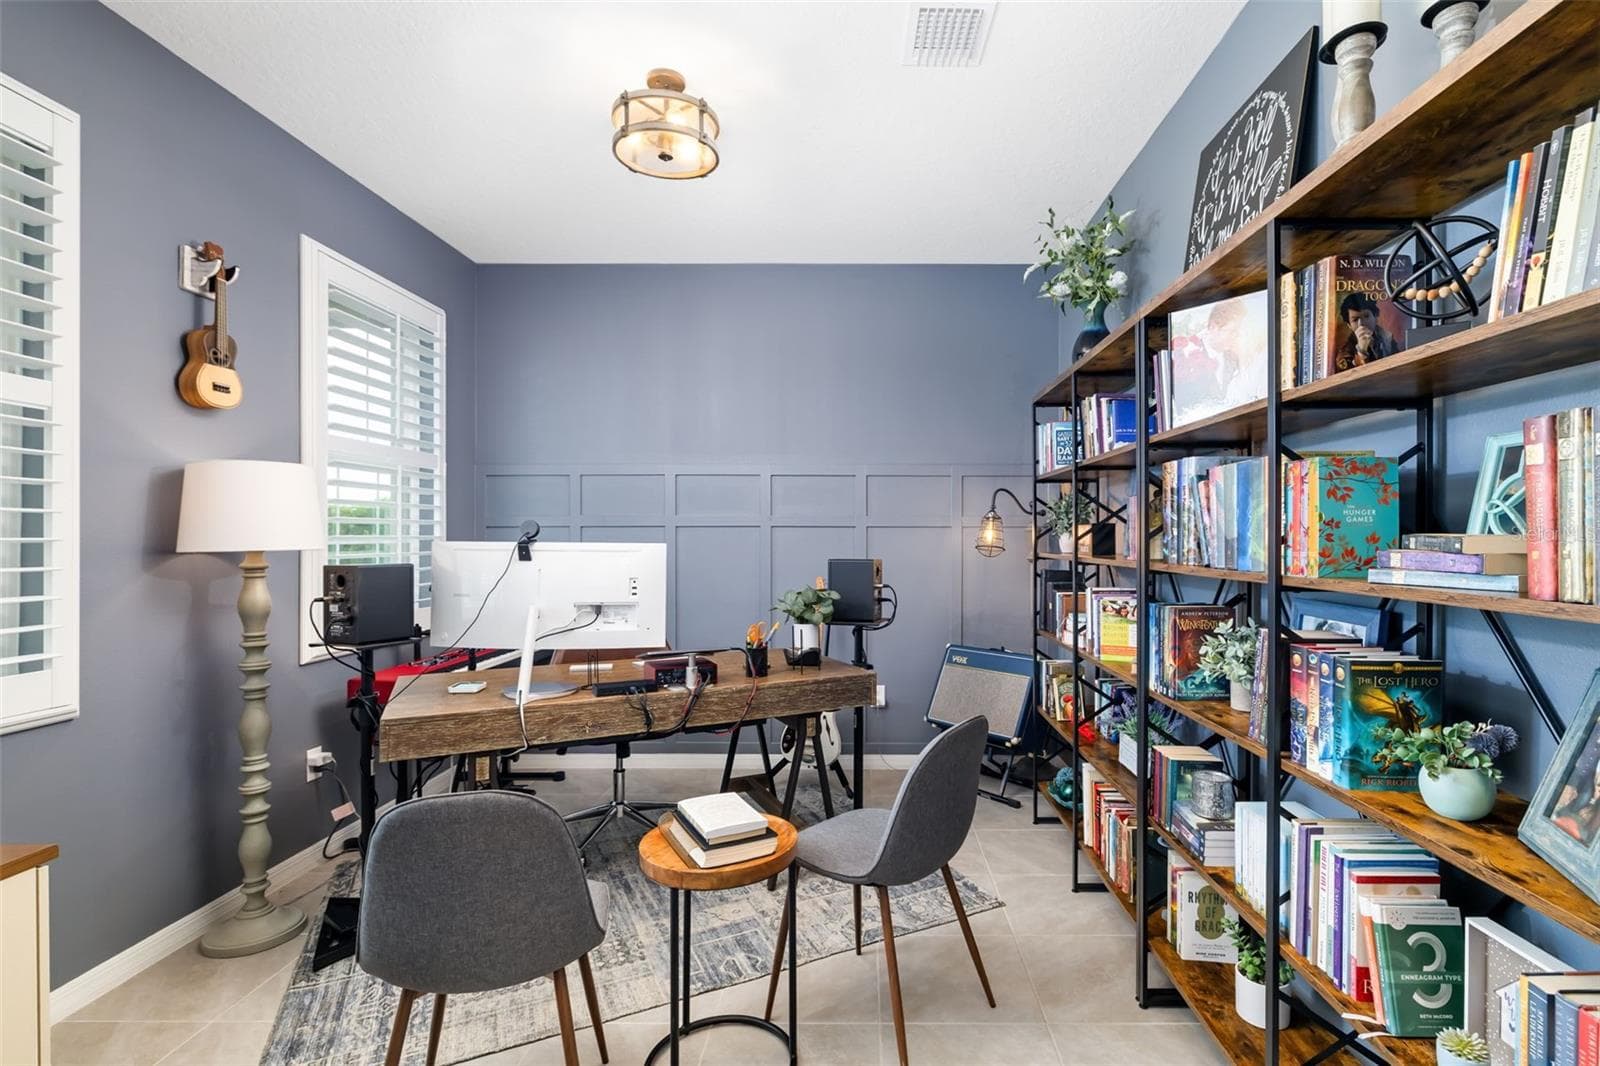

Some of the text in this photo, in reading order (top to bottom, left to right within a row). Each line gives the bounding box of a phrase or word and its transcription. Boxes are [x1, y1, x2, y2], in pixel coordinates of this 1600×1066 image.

[1538, 178, 1552, 224] HOBBIT
[1340, 259, 1405, 268] N. D. WILON
[952, 655, 968, 664] VOX
[1357, 676, 1440, 688] THE LOST HERO
[1361, 778, 1417, 786] RICK RIORD
[1188, 891, 1228, 905] RHYTH
[1205, 906, 1217, 918] OF
[1444, 974, 1462, 982] TYPE
[1536, 1009, 1544, 1060] SPIRITUAL
